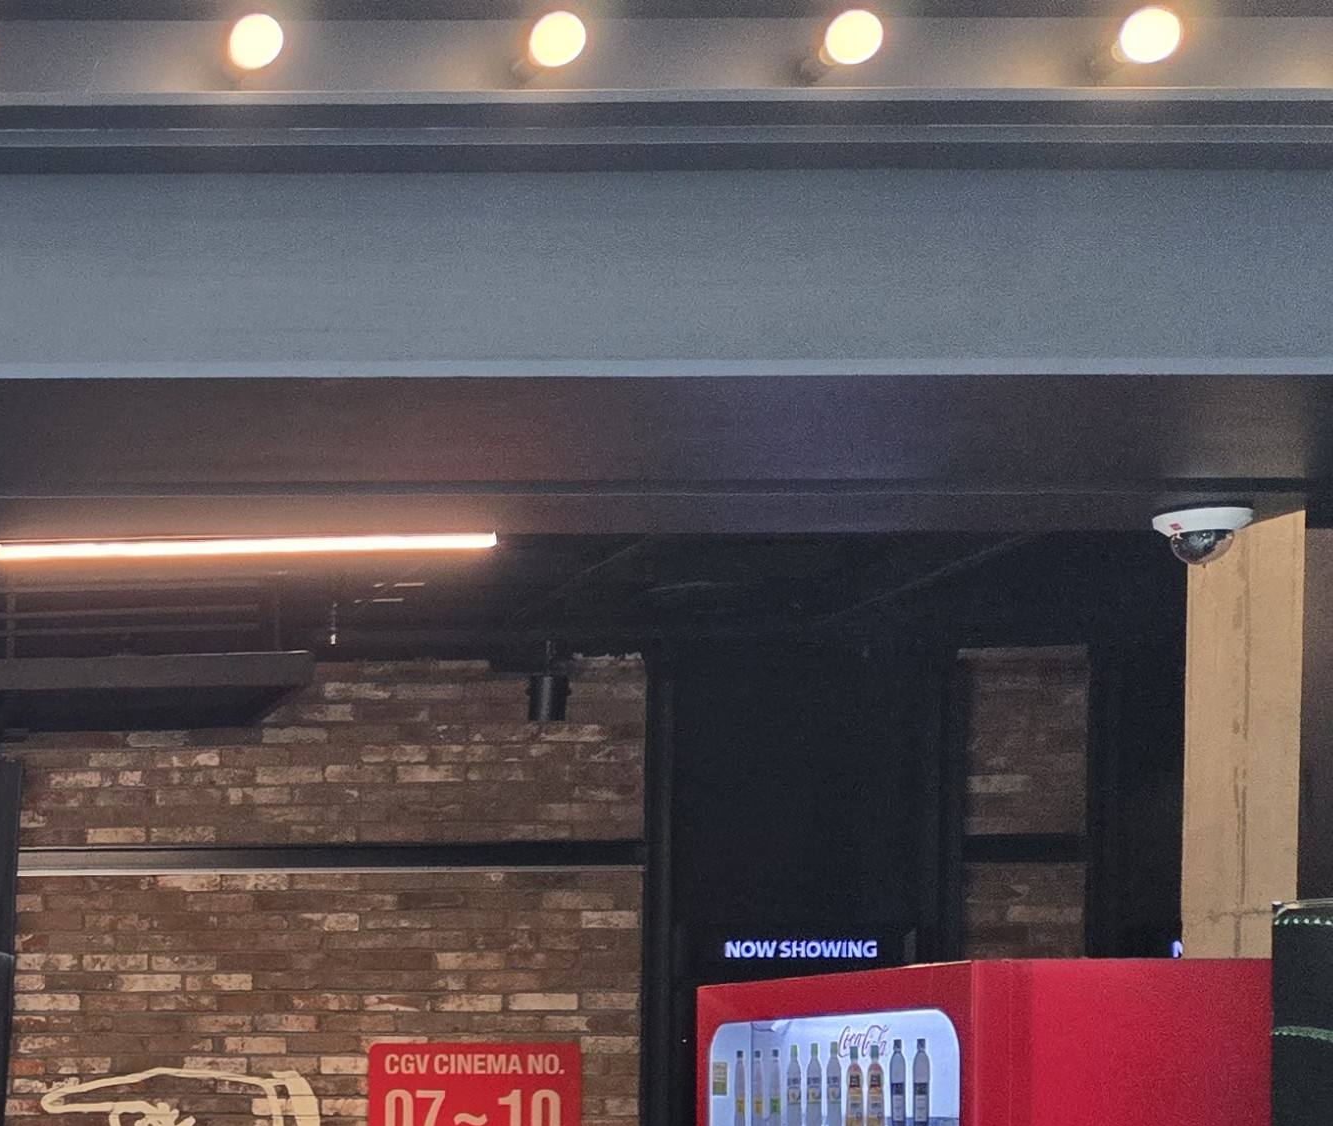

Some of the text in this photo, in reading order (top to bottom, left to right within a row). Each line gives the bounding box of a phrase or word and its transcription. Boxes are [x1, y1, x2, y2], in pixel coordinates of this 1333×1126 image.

[724, 940, 878, 958] NOW SHOWING
[384, 1053, 566, 1075] CGV CINEMA NO.
